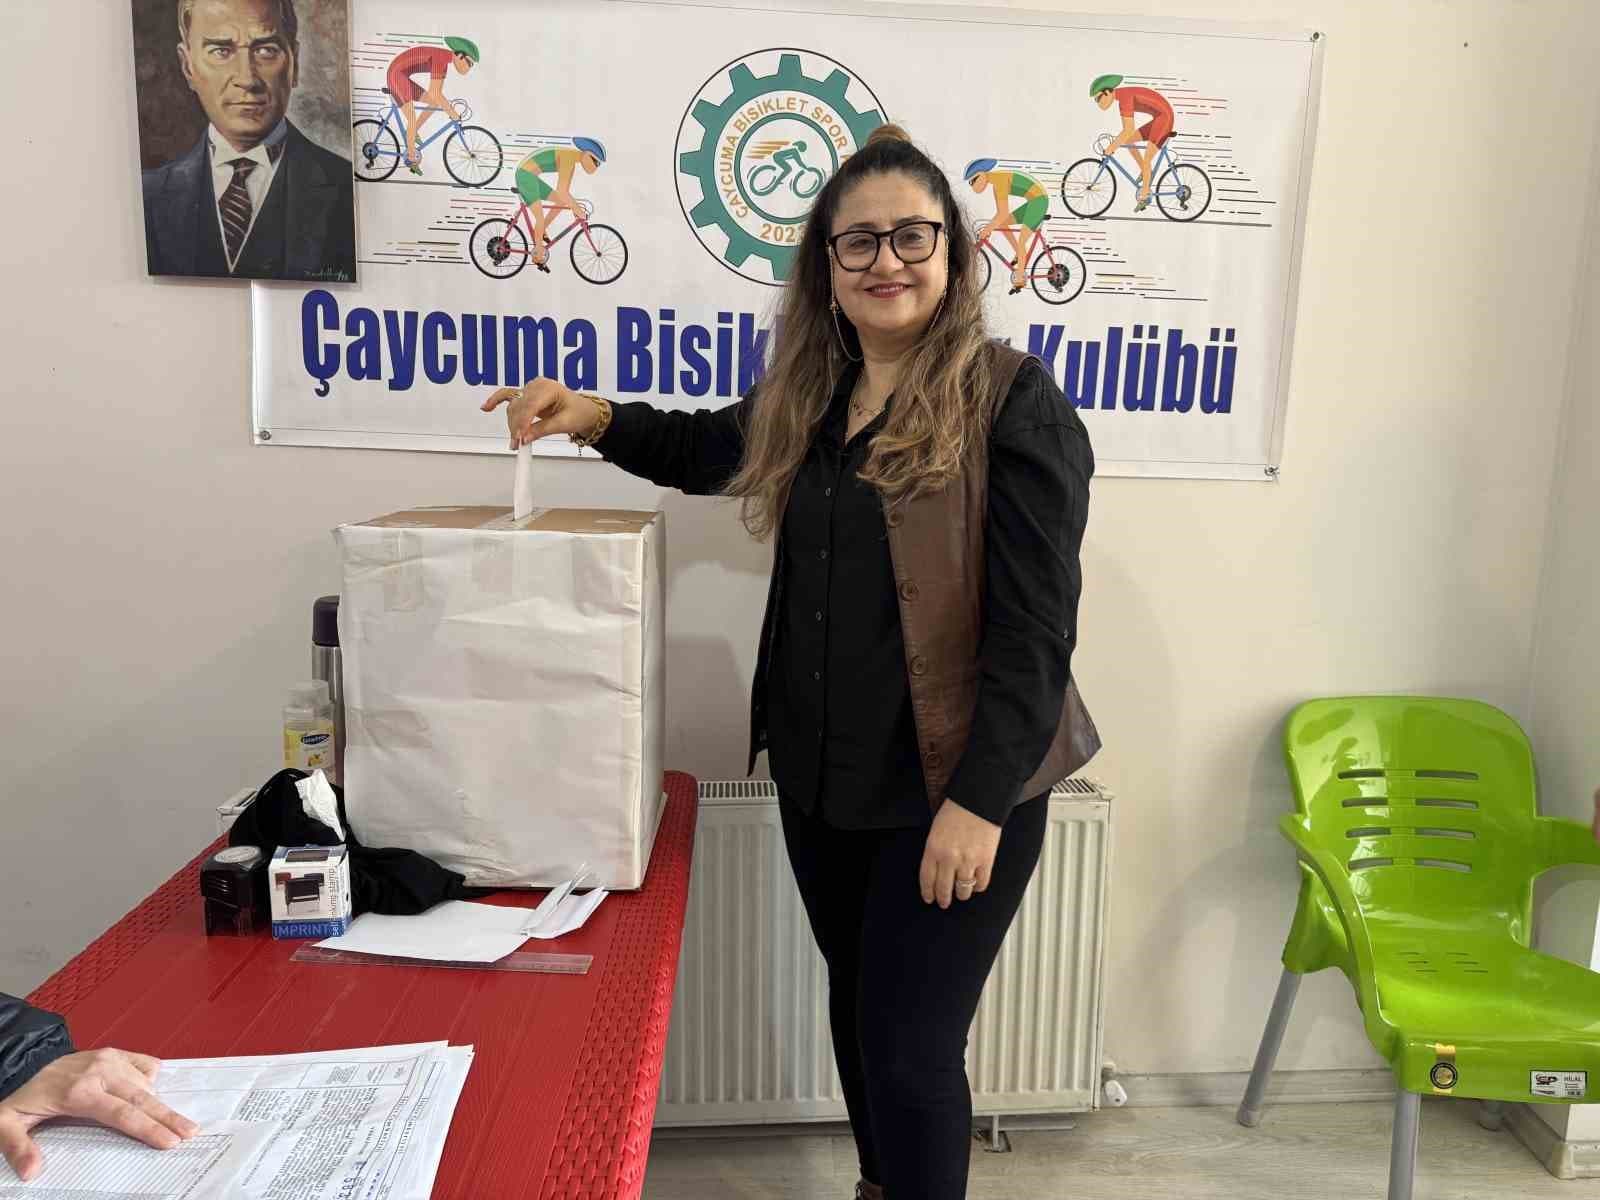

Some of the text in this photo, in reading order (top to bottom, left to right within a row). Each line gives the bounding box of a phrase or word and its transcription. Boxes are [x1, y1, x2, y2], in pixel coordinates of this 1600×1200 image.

[734, 97, 808, 132] BİSİKLET
[811, 106, 848, 149] SPOR
[301, 289, 598, 397] Çaycuma
[617, 306, 770, 397] Bisik
[274, 924, 328, 937] IMPRINT
